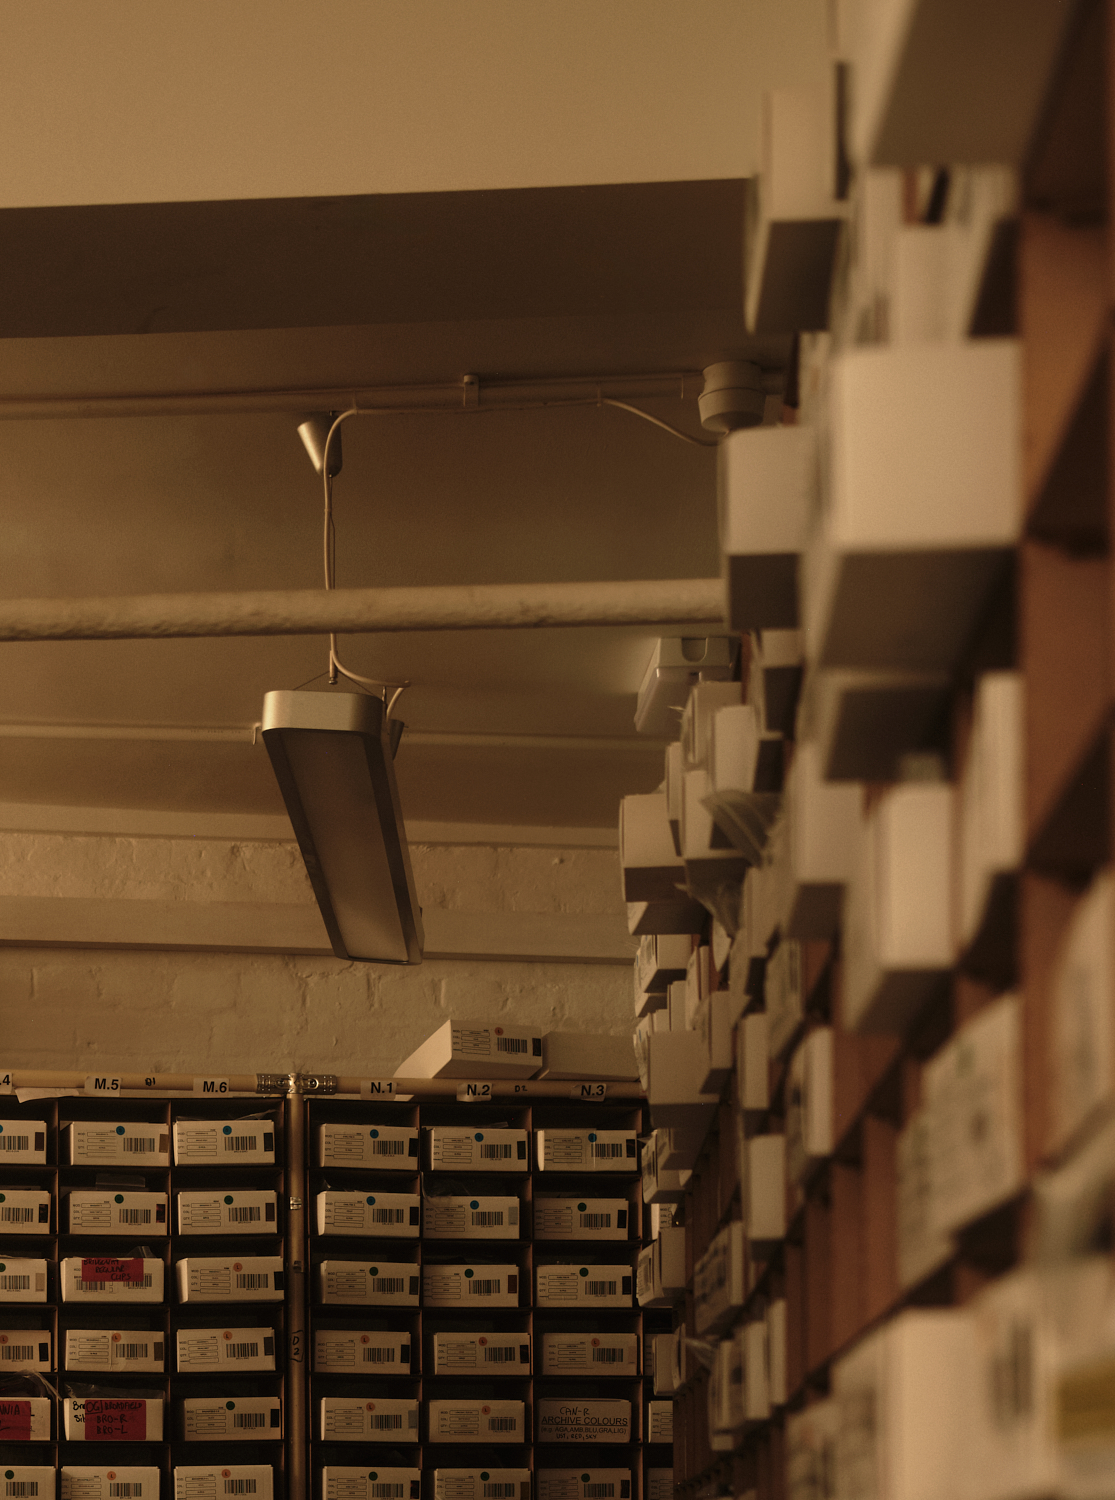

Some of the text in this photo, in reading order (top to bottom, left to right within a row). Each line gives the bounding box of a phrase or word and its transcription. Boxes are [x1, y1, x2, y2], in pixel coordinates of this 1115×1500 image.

[94, 1078, 119, 1091] M.5
[202, 1080, 228, 1093] M.6
[370, 1081, 393, 1094] N.1
[466, 1084, 491, 1096] N.2
[580, 1084, 605, 1096] N.3
[559, 1406, 590, 1416] CAN-R
[96, 1414, 128, 1424] BRO-R
[541, 1416, 628, 1426] ARCHIVE COLOURS
[96, 1425, 129, 1434] BRO-L
